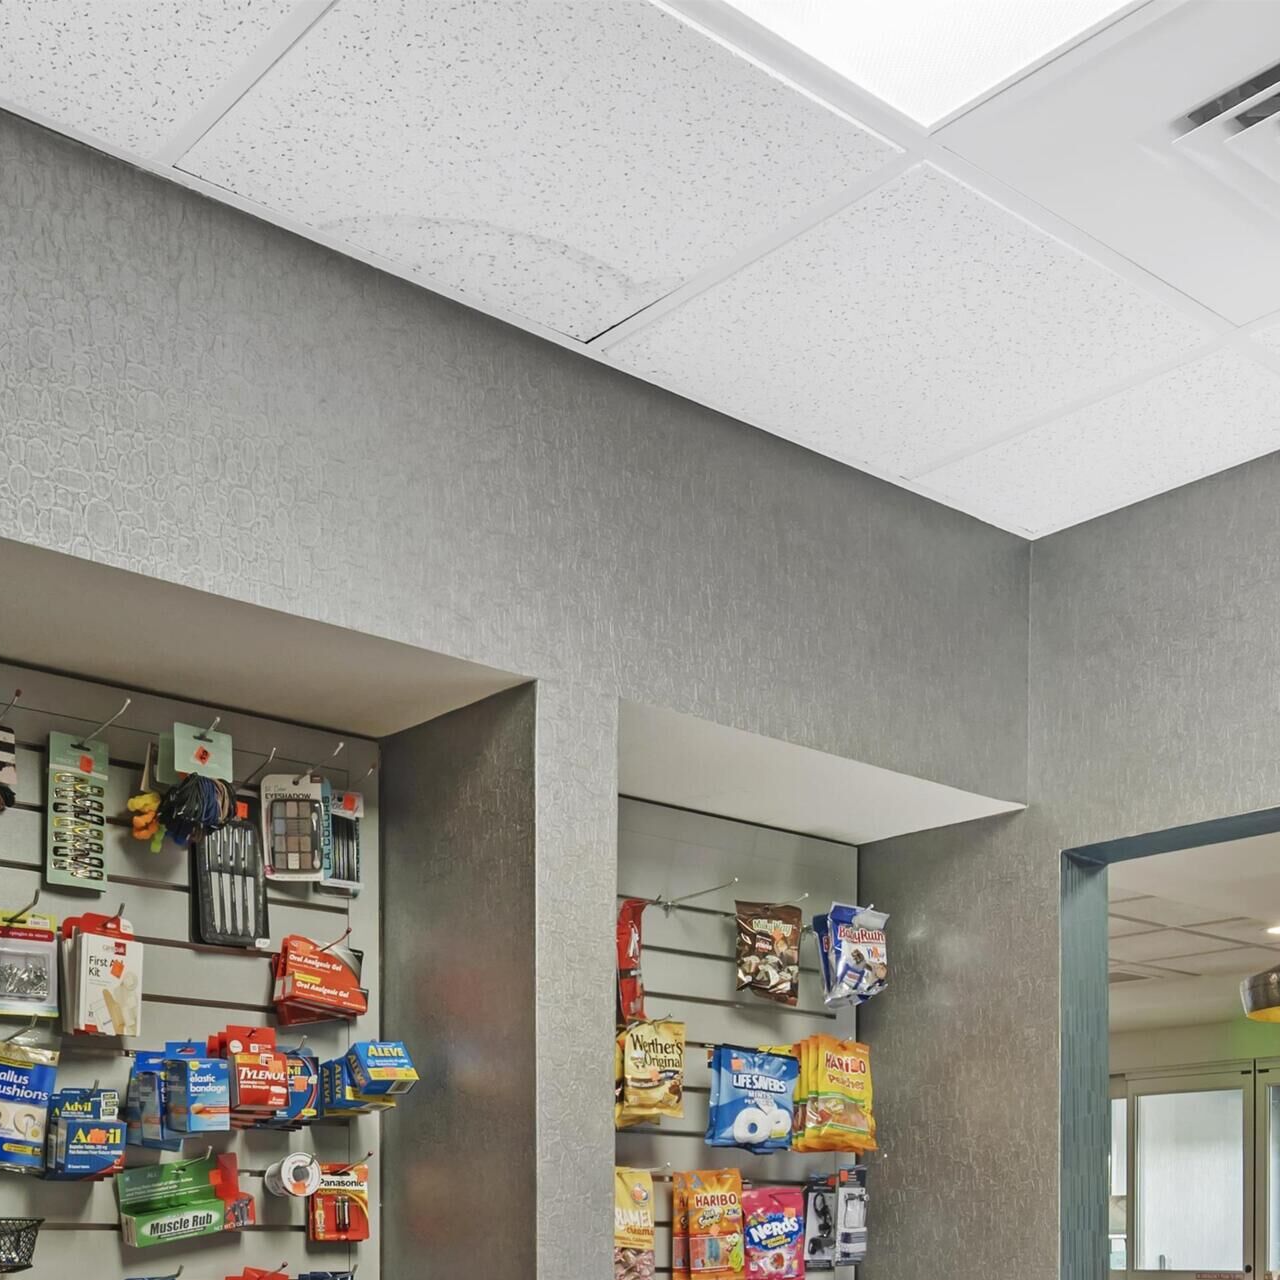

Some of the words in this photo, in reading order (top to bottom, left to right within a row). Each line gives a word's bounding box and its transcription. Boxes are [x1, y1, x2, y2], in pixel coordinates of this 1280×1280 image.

[321, 796, 333, 844] COLORS
[838, 925, 862, 944] Baby
[861, 929, 886, 944] Ruth
[88, 954, 109, 968] First
[288, 954, 304, 963] Oral
[331, 963, 343, 972] Gel
[88, 966, 102, 978] Kit
[296, 981, 310, 990] Oral
[338, 989, 350, 998] Gel
[367, 1044, 405, 1058] ALEVE
[630, 1033, 683, 1055] Werther's
[644, 1052, 683, 1070] Original
[825, 1053, 866, 1075] HARIO
[189, 1073, 216, 1083] elastic
[238, 1066, 287, 1082] TYLENOL
[347, 1054, 367, 1088] ALEVE
[189, 1083, 227, 1094] bandage
[334, 1063, 342, 1101] ALEVE
[733, 1074, 752, 1089] LIFE
[752, 1074, 787, 1094] SAVERS
[62, 1100, 93, 1113] Advil
[72, 1127, 122, 1145] Ail
[319, 1177, 365, 1188] Panasonic
[695, 1192, 738, 1208] HARIBO
[150, 1217, 191, 1236] Muscle
[192, 1212, 214, 1228] Rub
